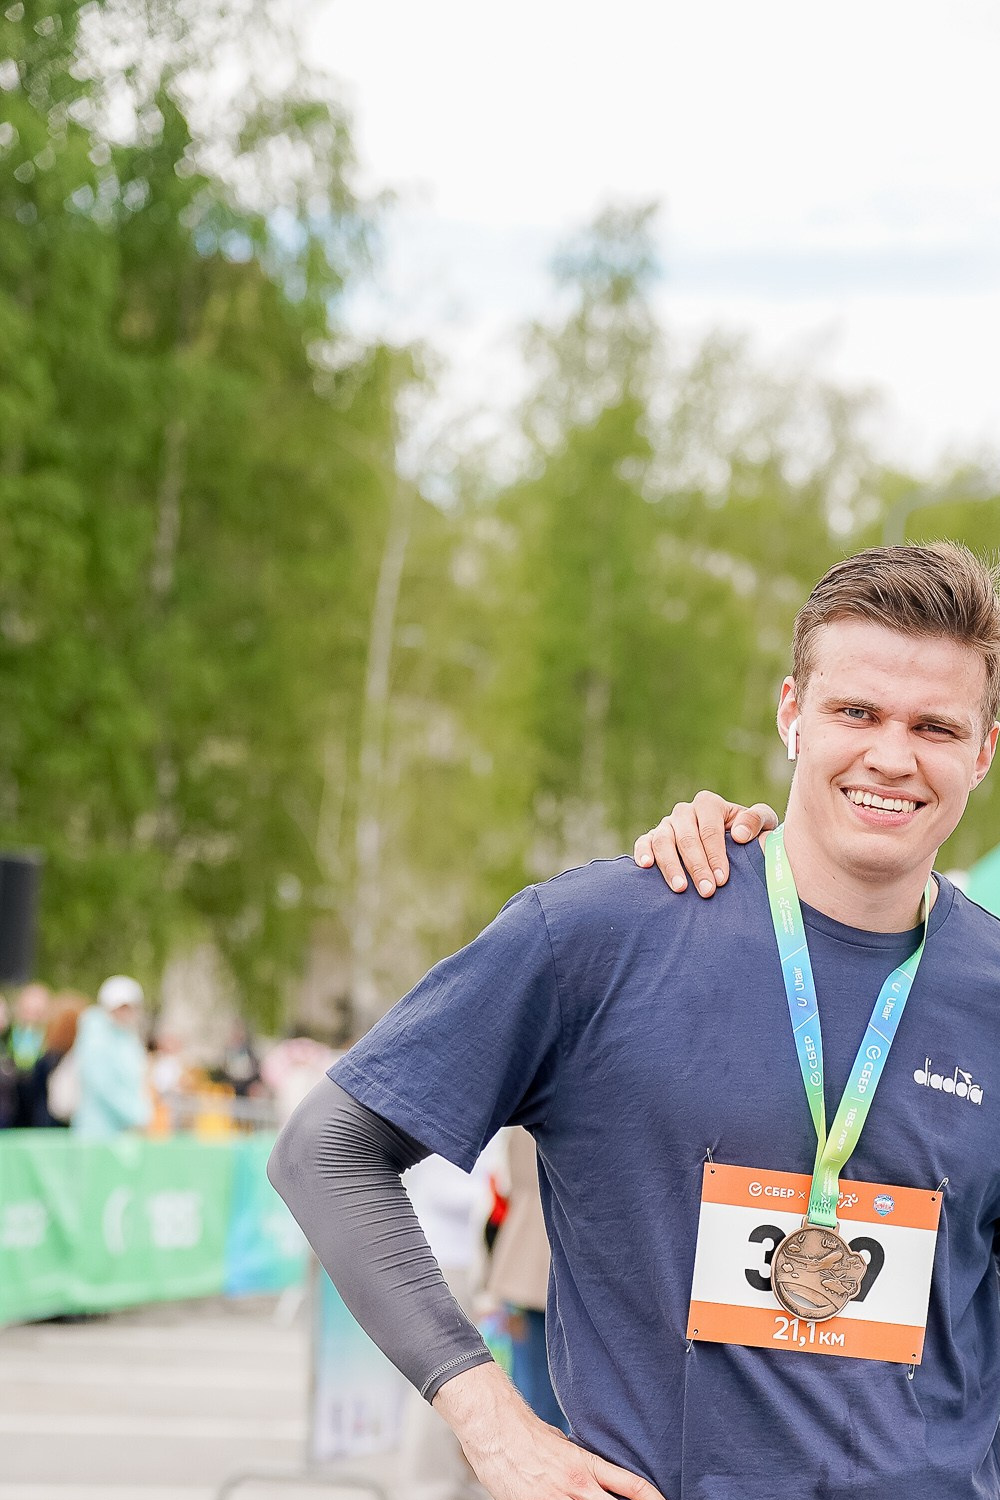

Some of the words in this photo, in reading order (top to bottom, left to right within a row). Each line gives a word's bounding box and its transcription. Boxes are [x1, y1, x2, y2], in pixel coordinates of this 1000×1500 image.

[792, 967, 805, 991] Utair
[881, 997, 897, 1021] Utair
[804, 1035, 818, 1069] СБЕР
[857, 1061, 875, 1095] СБЕР
[913, 1056, 984, 1107] diadora
[844, 1107, 858, 1128] 185
[837, 1130, 848, 1153] лет
[764, 1185, 795, 1199] СБЕР
[745, 1224, 885, 1303] 39
[772, 1315, 816, 1347] 21,1
